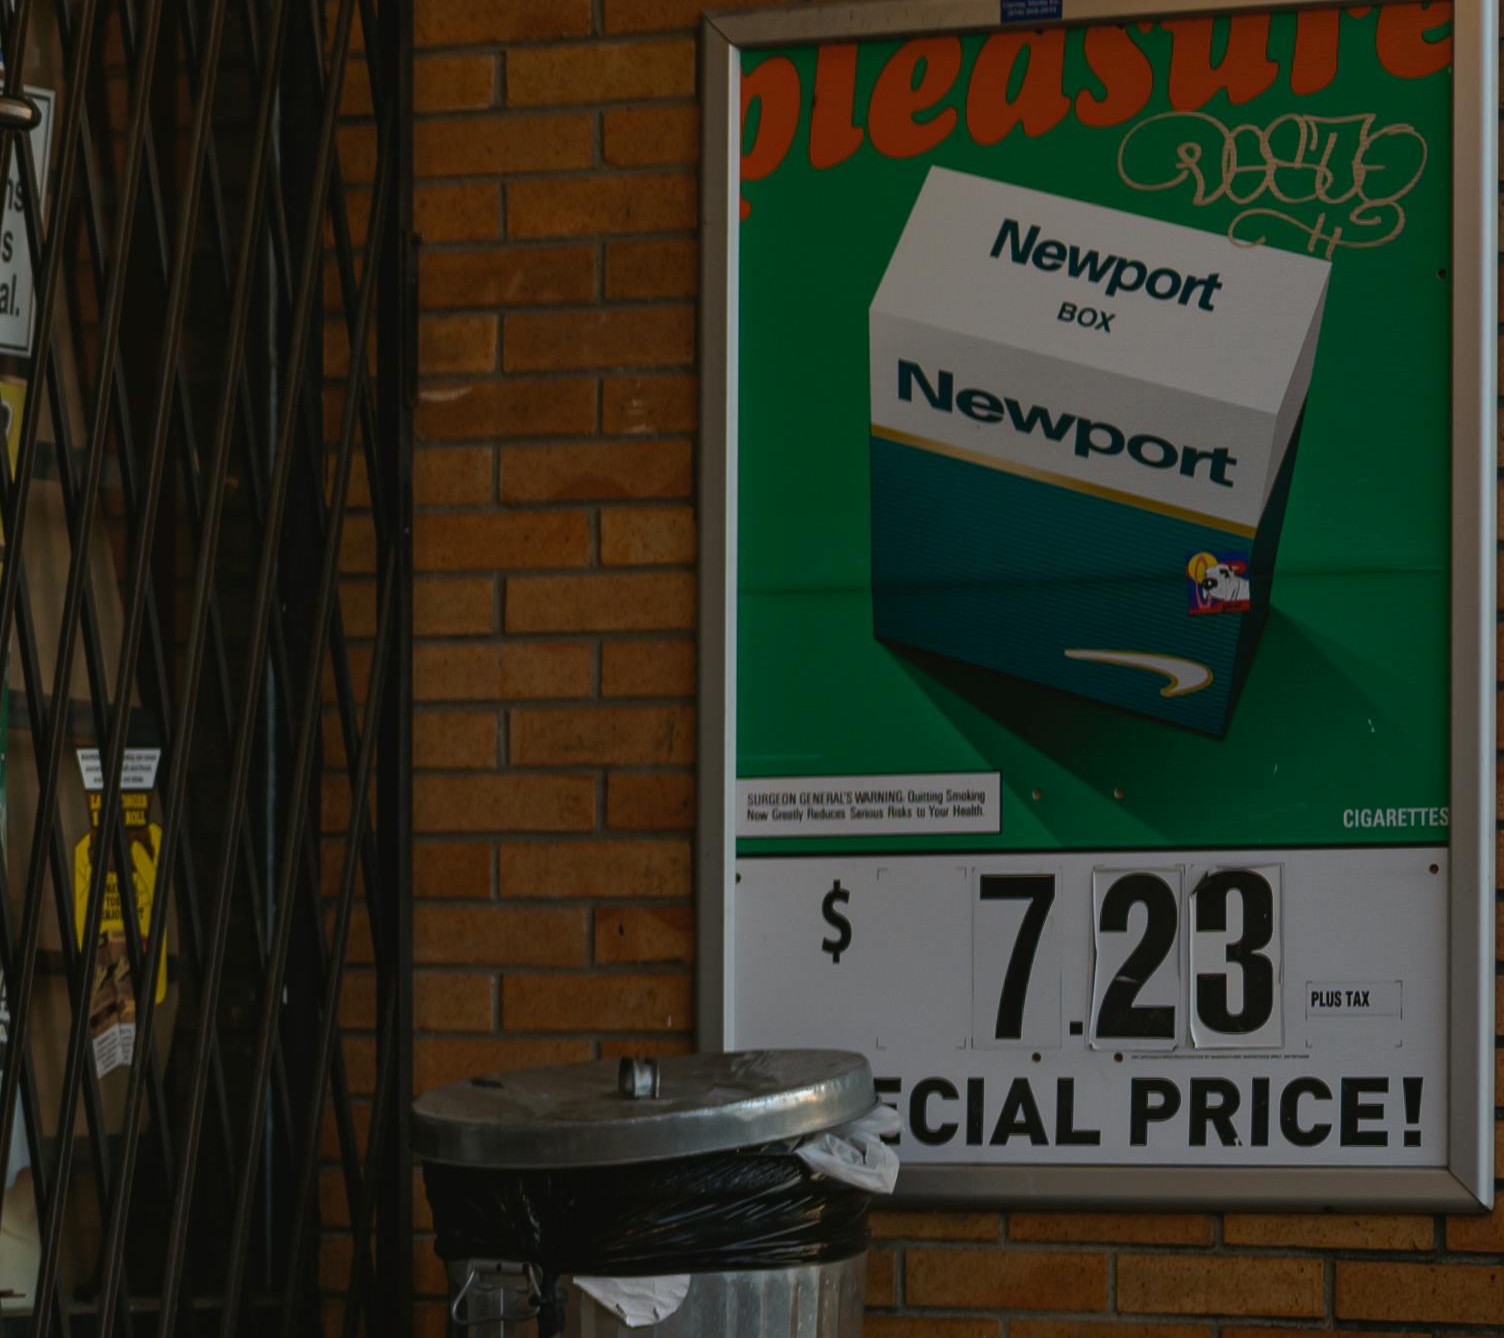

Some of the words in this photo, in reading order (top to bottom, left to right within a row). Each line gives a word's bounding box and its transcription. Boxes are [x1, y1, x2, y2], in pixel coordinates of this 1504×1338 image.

[739, 0, 1453, 220] pleasure
[990, 218, 1223, 311] Newport
[1056, 302, 1116, 333] BOX
[897, 358, 1238, 487] Newport
[746, 791, 799, 806] SURGEON
[799, 790, 854, 806] GENERAL'S
[907, 788, 944, 806] Quitting
[946, 788, 987, 805] Smoking
[746, 809, 769, 822] Now
[771, 808, 804, 824] Greatly
[806, 808, 847, 821] Reduces
[849, 807, 886, 820] Serious
[888, 806, 913, 819] Risks
[916, 806, 926, 818] to
[928, 805, 949, 818] Your
[952, 804, 984, 817] Health.
[1341, 808, 1449, 829] CIGARETTES
[821, 878, 852, 964] $
[979, 869, 1274, 1040] 7.23
[1310, 990, 1342, 1008] PLUS
[1345, 990, 1370, 1008] TAX
[874, 1076, 1101, 1147] ECIAL
[1128, 1076, 1424, 1148] PRICE!
